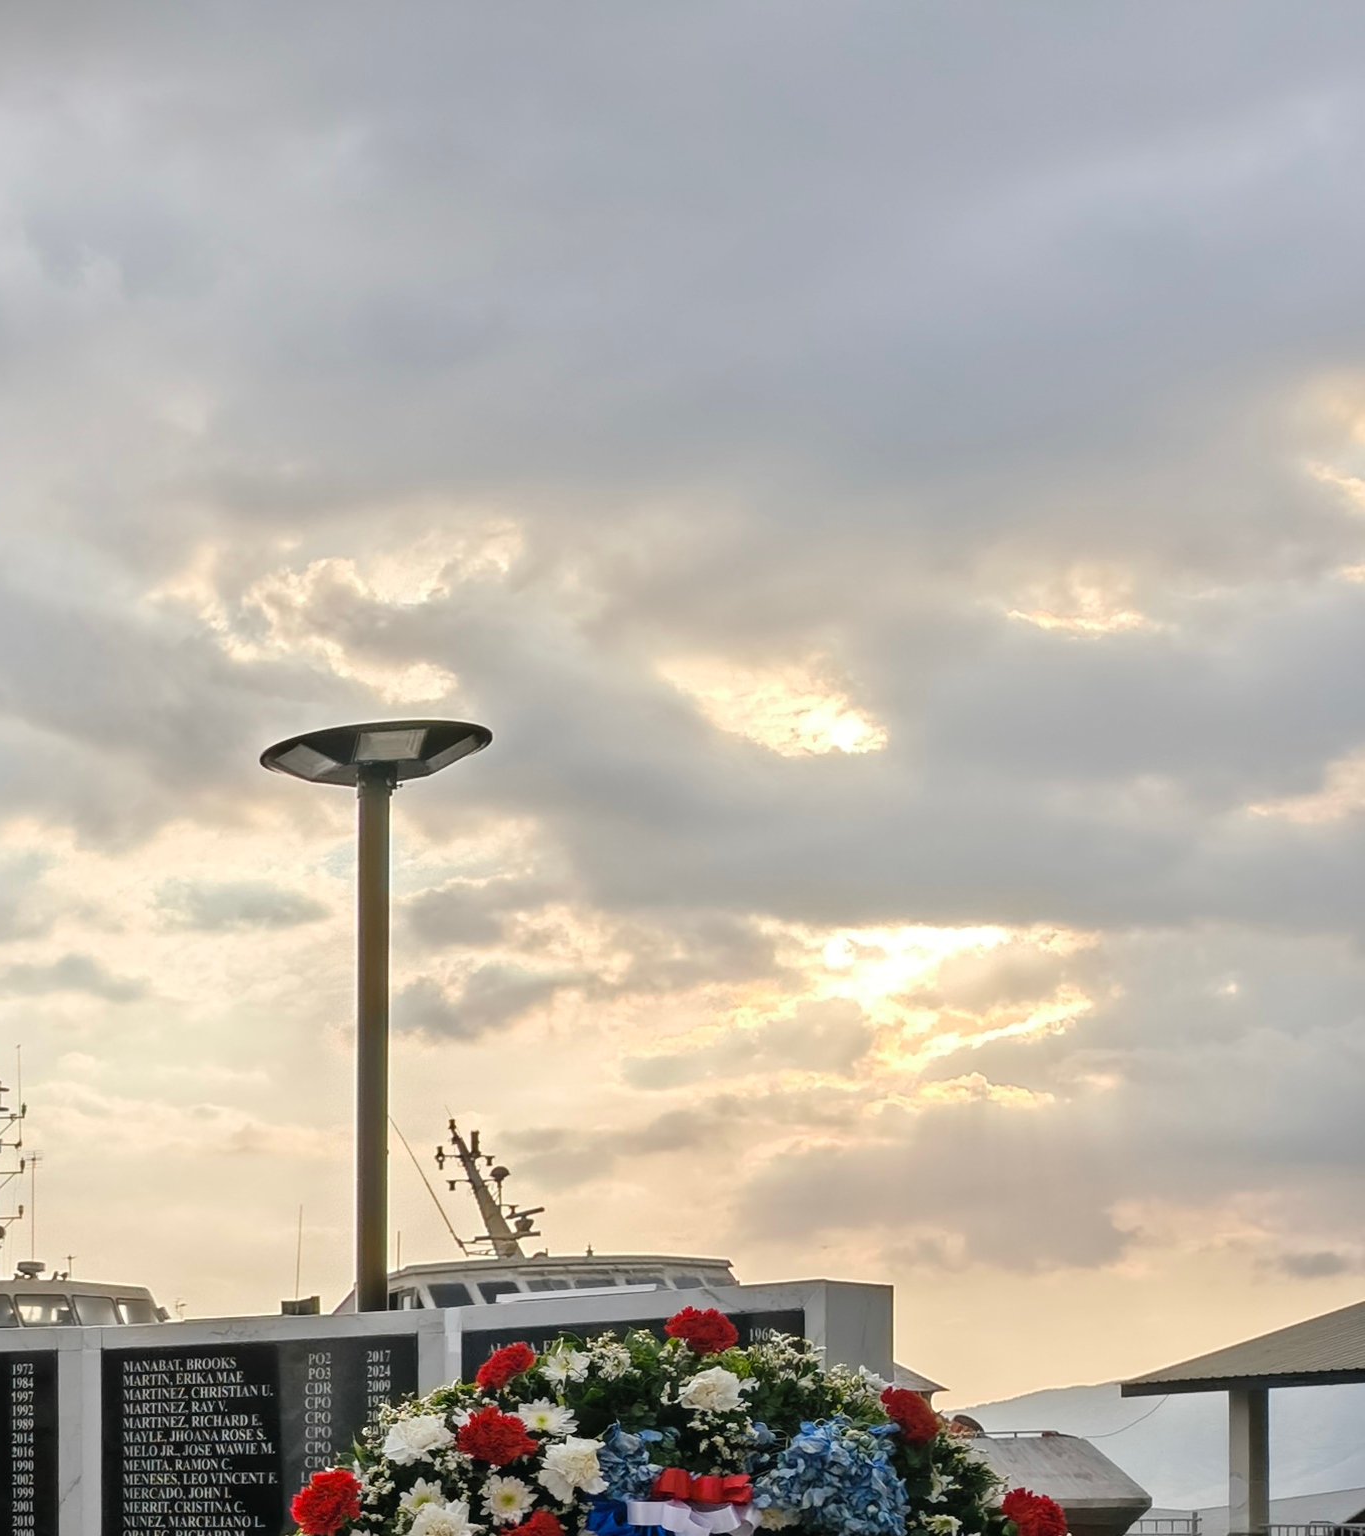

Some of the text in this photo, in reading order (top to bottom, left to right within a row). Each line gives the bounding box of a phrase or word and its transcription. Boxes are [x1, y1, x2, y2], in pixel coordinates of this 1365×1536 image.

[186, 1357, 237, 1371] BROOKS
[308, 1353, 332, 1365] PO2
[366, 1350, 391, 1363] 2017
[12, 1363, 34, 1375] 1972
[123, 1365, 391, 1387] MARTIN, ERIKA MAE PO3 2024
[12, 1377, 34, 1389] 1984
[123, 1380, 391, 1401] MARTINEZ, CHRISTIAN U. CDR 2009
[12, 1405, 34, 1417] 1992
[12, 1419, 34, 1431] 1989
